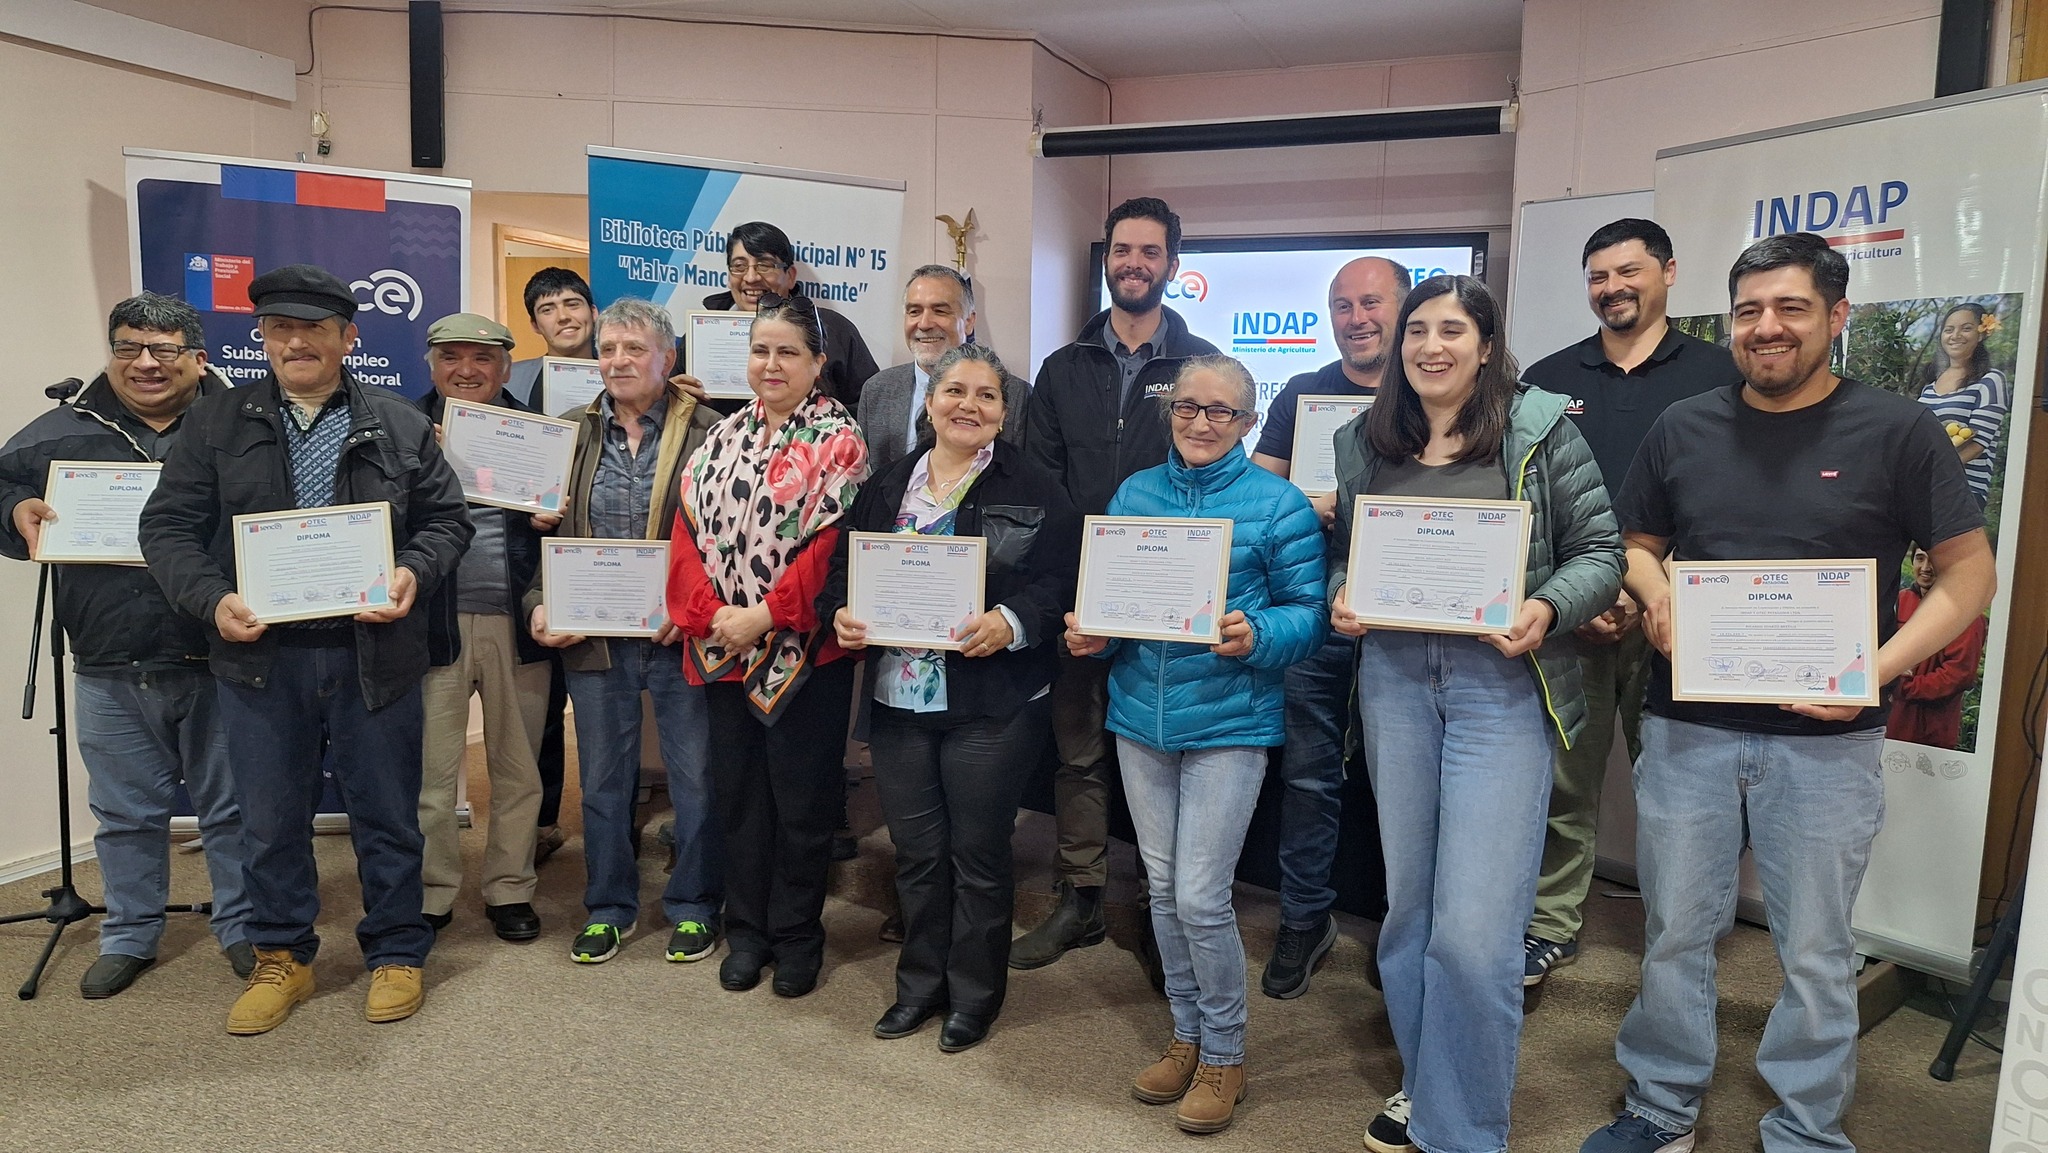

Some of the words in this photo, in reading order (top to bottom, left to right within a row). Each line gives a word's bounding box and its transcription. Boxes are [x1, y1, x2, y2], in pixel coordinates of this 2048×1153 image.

[1753, 180, 1909, 239] INDAP
[601, 217, 689, 251] Biblioteca
[790, 241, 841, 268] nicipal
[870, 248, 887, 271] 15
[619, 255, 680, 284] "Malva
[684, 263, 727, 288] Manc
[796, 280, 868, 302] amante"
[1233, 311, 1319, 335] INDAP
[1277, 346, 1316, 354] Agricultura
[222, 345, 268, 361] Subsi
[342, 353, 390, 368] mpleo
[353, 372, 402, 386] aboral
[496, 430, 525, 440] DIPLOMA
[1431, 510, 1454, 518] OTEC
[1477, 511, 1507, 520] INDAP
[1187, 529, 1211, 537] INDAP
[1417, 527, 1455, 536] DIPLOMA
[296, 532, 331, 541] DIPLOMA
[901, 559, 931, 567] DIPLOMA
[1762, 573, 1788, 581] OTEC
[1817, 571, 1850, 580] INDAP
[1748, 593, 1793, 601] DIPLOMA
